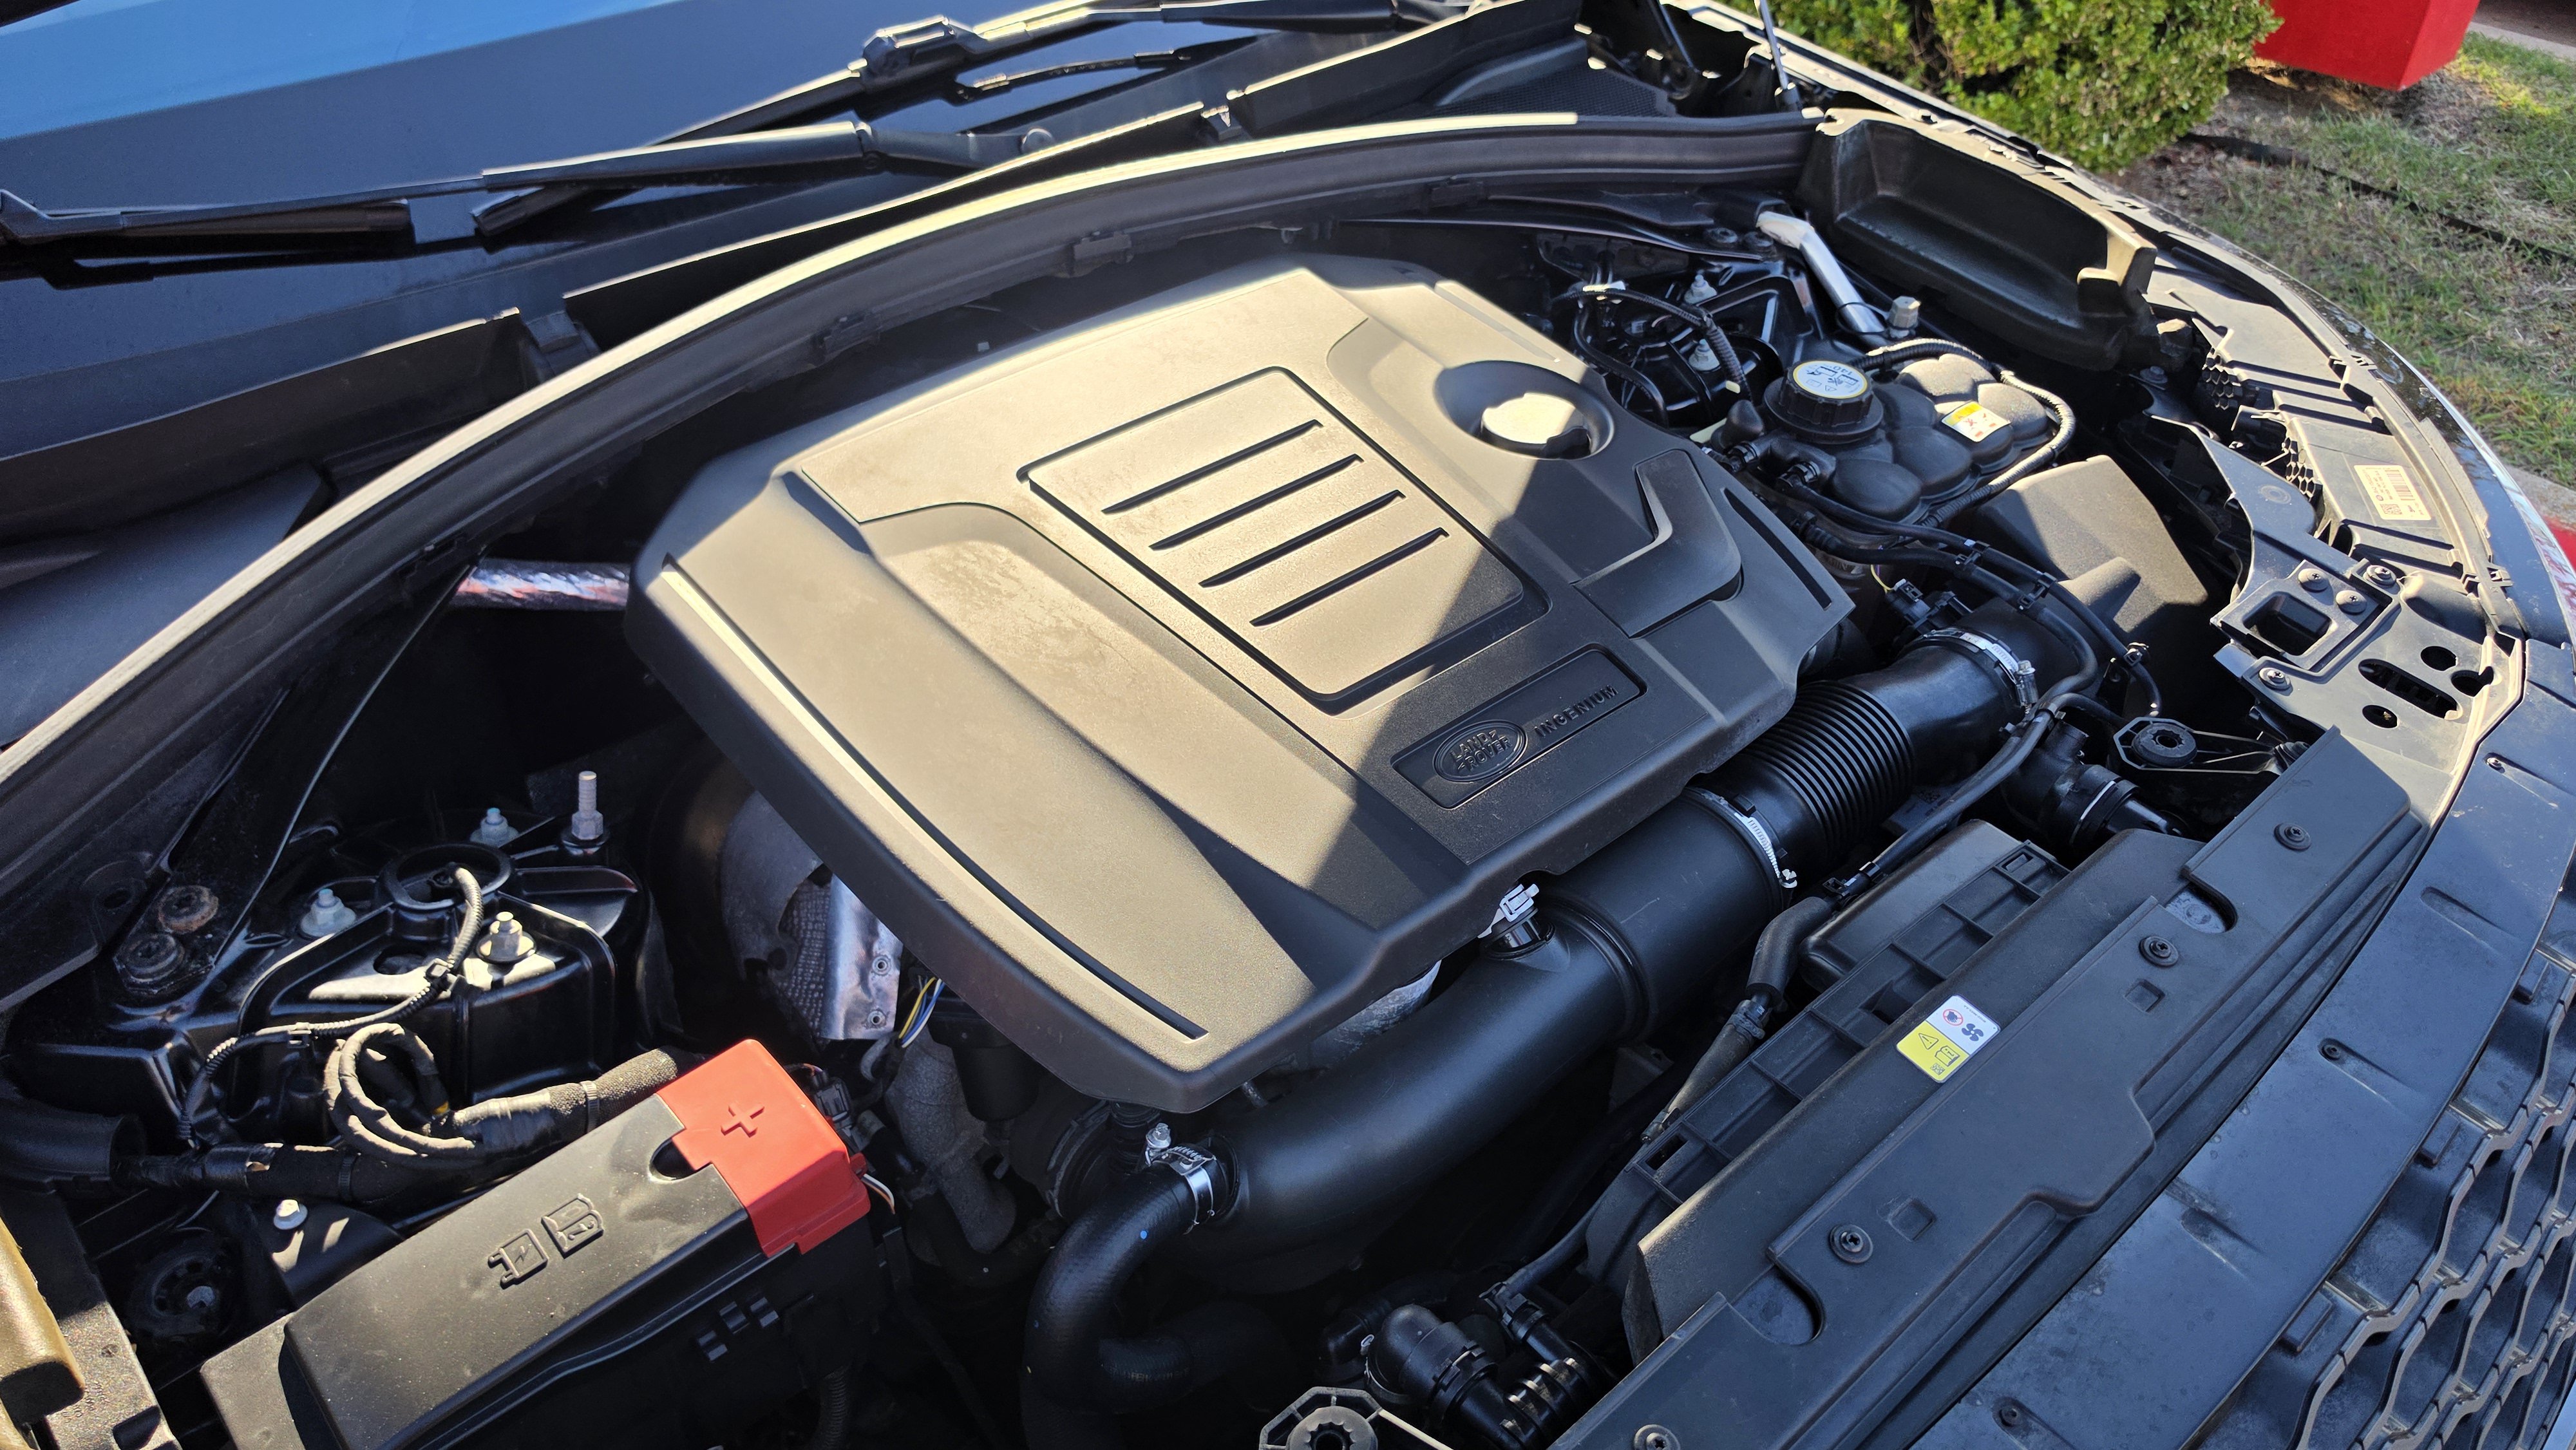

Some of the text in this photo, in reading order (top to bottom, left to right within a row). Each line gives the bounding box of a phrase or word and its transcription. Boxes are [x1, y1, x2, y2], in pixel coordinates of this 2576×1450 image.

[1533, 684, 1619, 738] INGENIUM
[1450, 732, 1492, 762] LAND
[1464, 735, 1513, 771] ROVER
